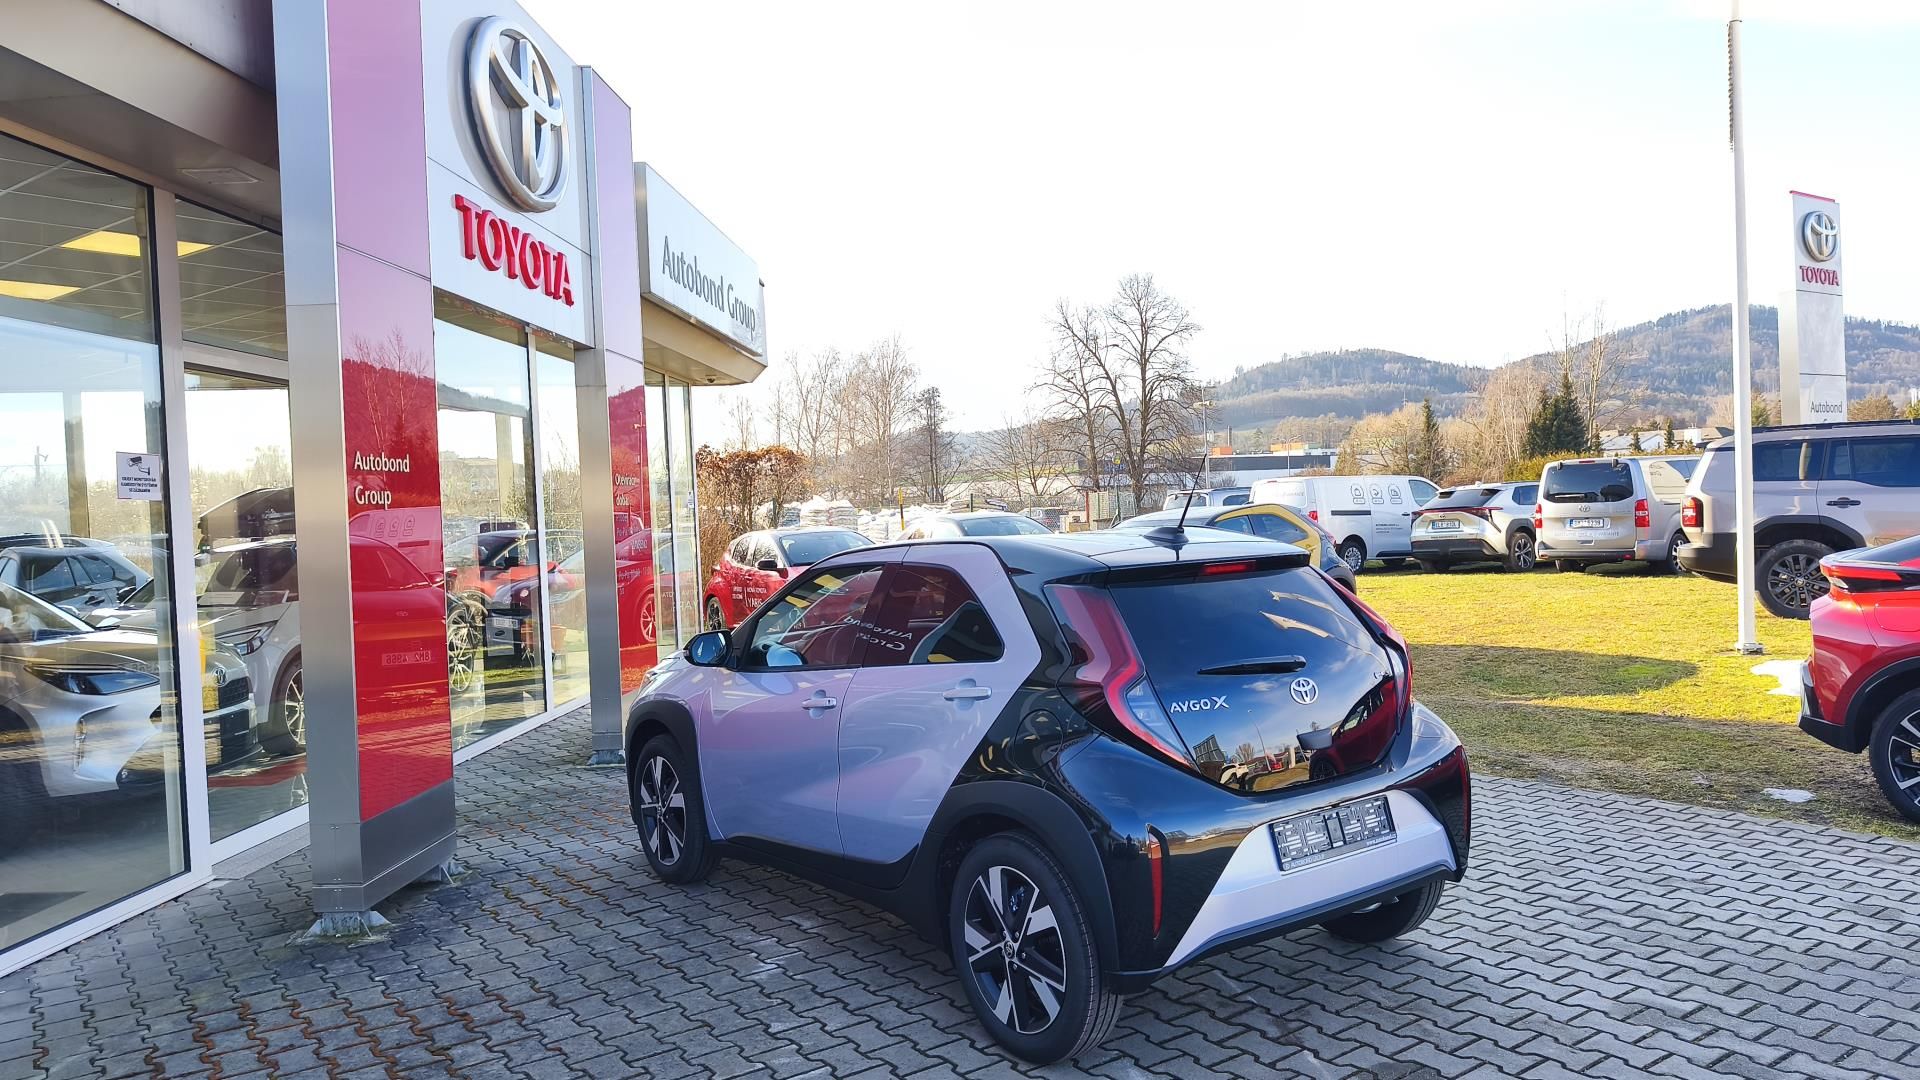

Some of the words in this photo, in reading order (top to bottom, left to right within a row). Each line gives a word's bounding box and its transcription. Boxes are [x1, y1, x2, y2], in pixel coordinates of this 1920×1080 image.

[454, 193, 575, 307] TOYOTA
[1799, 265, 1840, 287] TOYOTA
[662, 235, 725, 313] Autobond
[727, 283, 756, 342] Group
[1810, 400, 1843, 414] Autobond
[354, 450, 410, 473] Autobond
[355, 485, 392, 511] Group
[1170, 698, 1211, 714] AYGO
[1210, 695, 1230, 710] X
